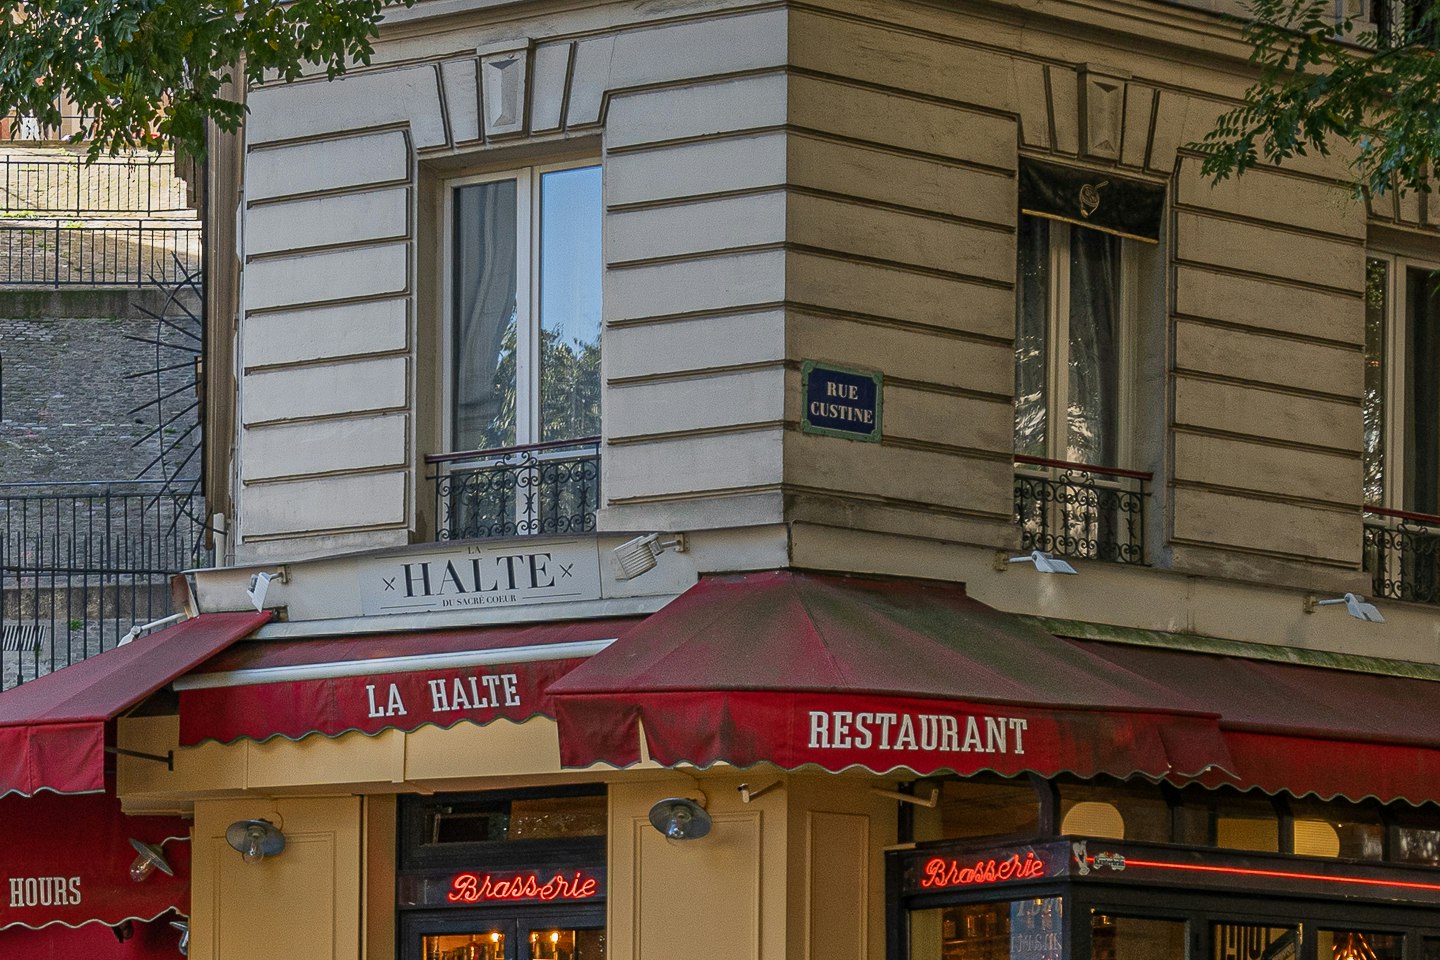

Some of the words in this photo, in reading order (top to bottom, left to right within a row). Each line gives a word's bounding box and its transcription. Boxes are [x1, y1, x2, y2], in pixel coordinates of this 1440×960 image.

[827, 381, 858, 400] RUE
[810, 401, 873, 424] CUSTINE
[468, 546, 481, 554] LA
[401, 552, 555, 598] HALTE
[442, 599, 454, 607] DU
[456, 594, 485, 605] SACRÉ
[366, 683, 407, 718] LA
[428, 674, 520, 712] HALTE
[808, 711, 1028, 755] RESTAURANT
[921, 851, 1045, 888] Brasserie
[9, 876, 82, 908] HOURS
[447, 871, 597, 902] Brasserie
